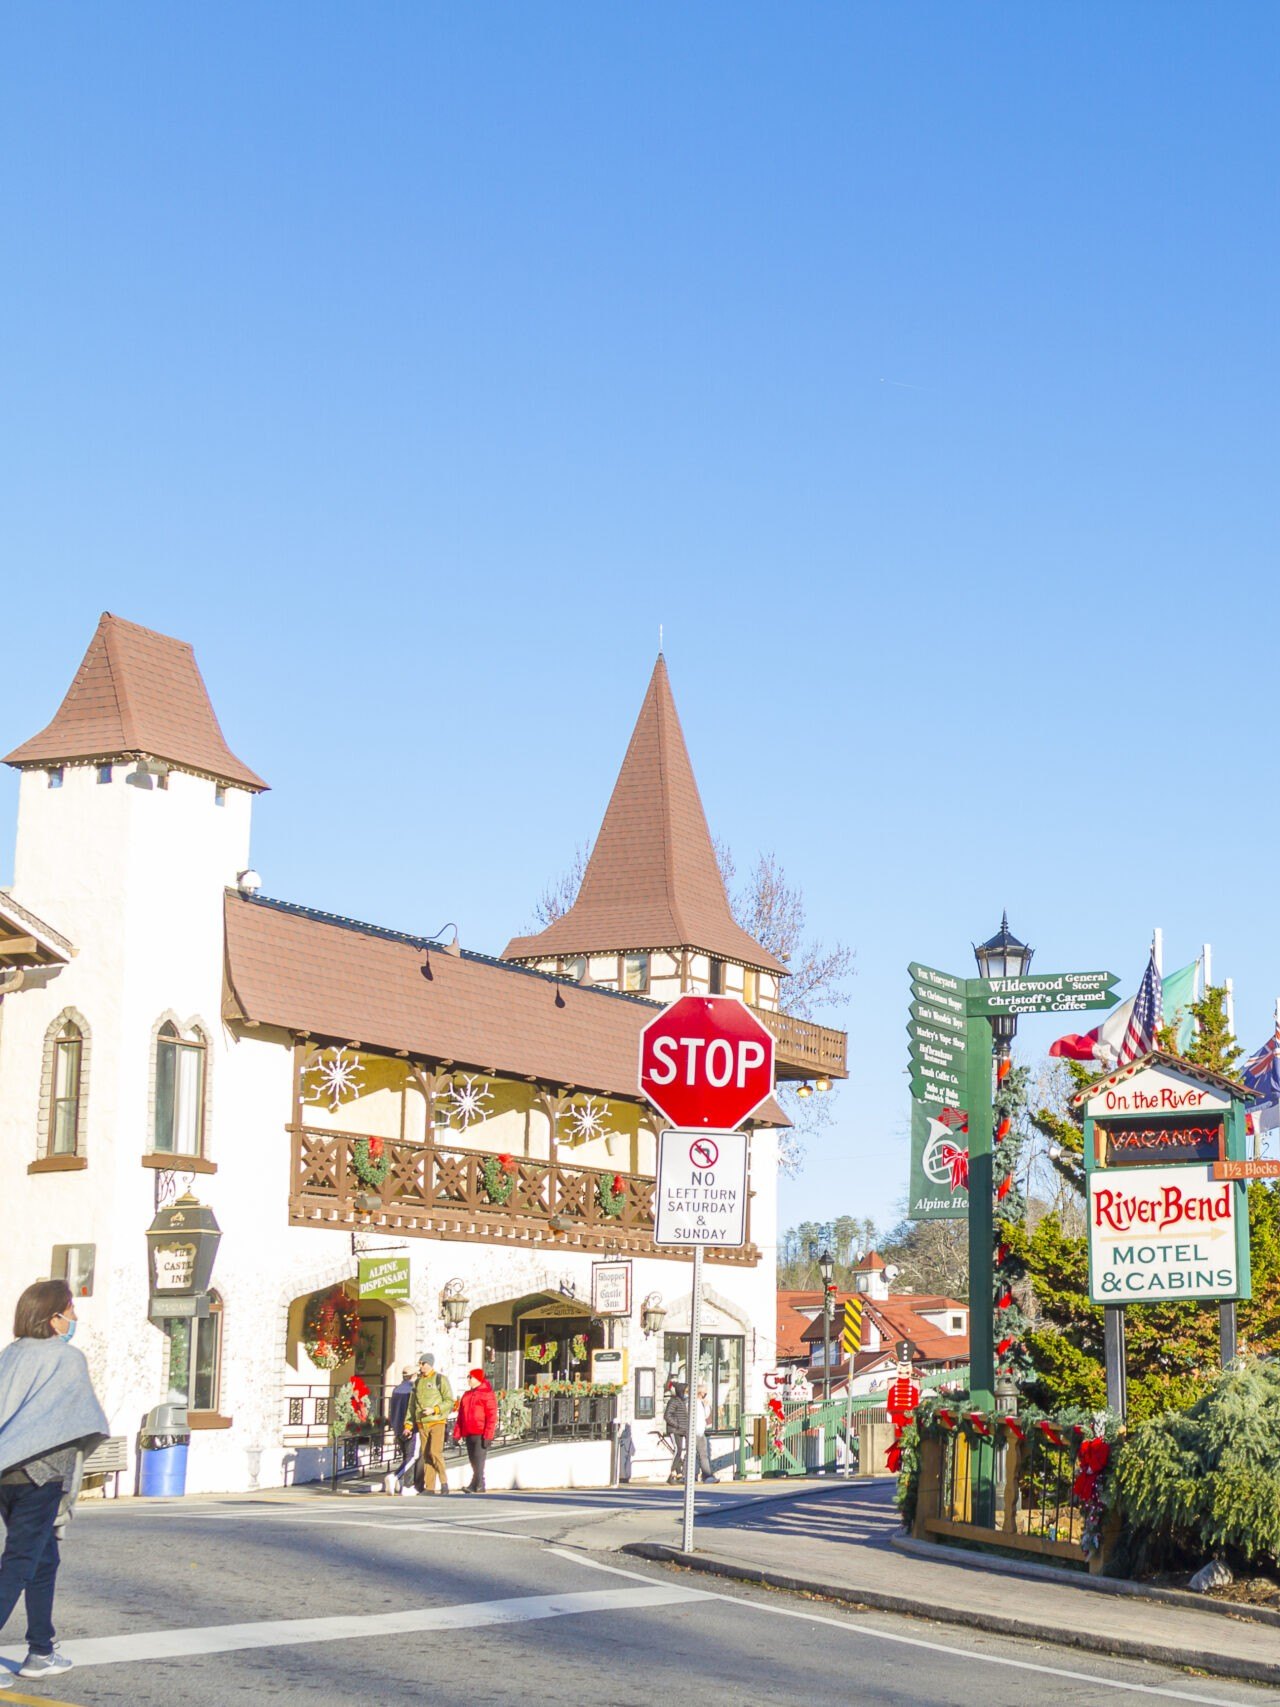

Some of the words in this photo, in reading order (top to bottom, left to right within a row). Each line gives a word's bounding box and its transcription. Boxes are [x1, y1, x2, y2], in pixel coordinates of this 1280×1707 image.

[930, 972, 957, 989] Vineyards
[989, 978, 1063, 993] Wildewood
[1065, 972, 1108, 983] General
[1072, 981, 1100, 990] Store
[918, 987, 927, 997] The
[927, 990, 948, 1005] Christmas
[948, 997, 962, 1011] Shoppe
[988, 994, 1052, 1006] Christoff's
[1056, 991, 1105, 1002] Caramel
[1009, 1004, 1036, 1013] Corn
[1051, 1001, 1087, 1011] Coffee
[933, 1011, 952, 1025] Wooden
[952, 1017, 963, 1030] Toys
[940, 1033, 952, 1045] Vape
[952, 1037, 965, 1050] Shop
[649, 1035, 765, 1089] STOP
[936, 1070, 950, 1082] Coffee
[1105, 1091, 1130, 1110] On
[1132, 1090, 1158, 1109] the
[1160, 1088, 1209, 1109] River
[1108, 1127, 1219, 1150] VACANCY
[1244, 1162, 1278, 1176] Blocks
[691, 1171, 715, 1186] NO
[667, 1187, 698, 1199] LEFT
[703, 1188, 736, 1200] TURN
[667, 1201, 735, 1213] SATURDAY
[914, 1197, 950, 1212] Alpine
[951, 1197, 969, 1209] He
[696, 1215, 706, 1226] &
[674, 1227, 727, 1239] SUNDAY
[1112, 1244, 1208, 1265] MOTEL
[368, 1260, 398, 1279] ALPINE
[171, 1275, 191, 1284] INN
[360, 1268, 409, 1294] DISPENSARY
[763, 1372, 792, 1390] Troll
